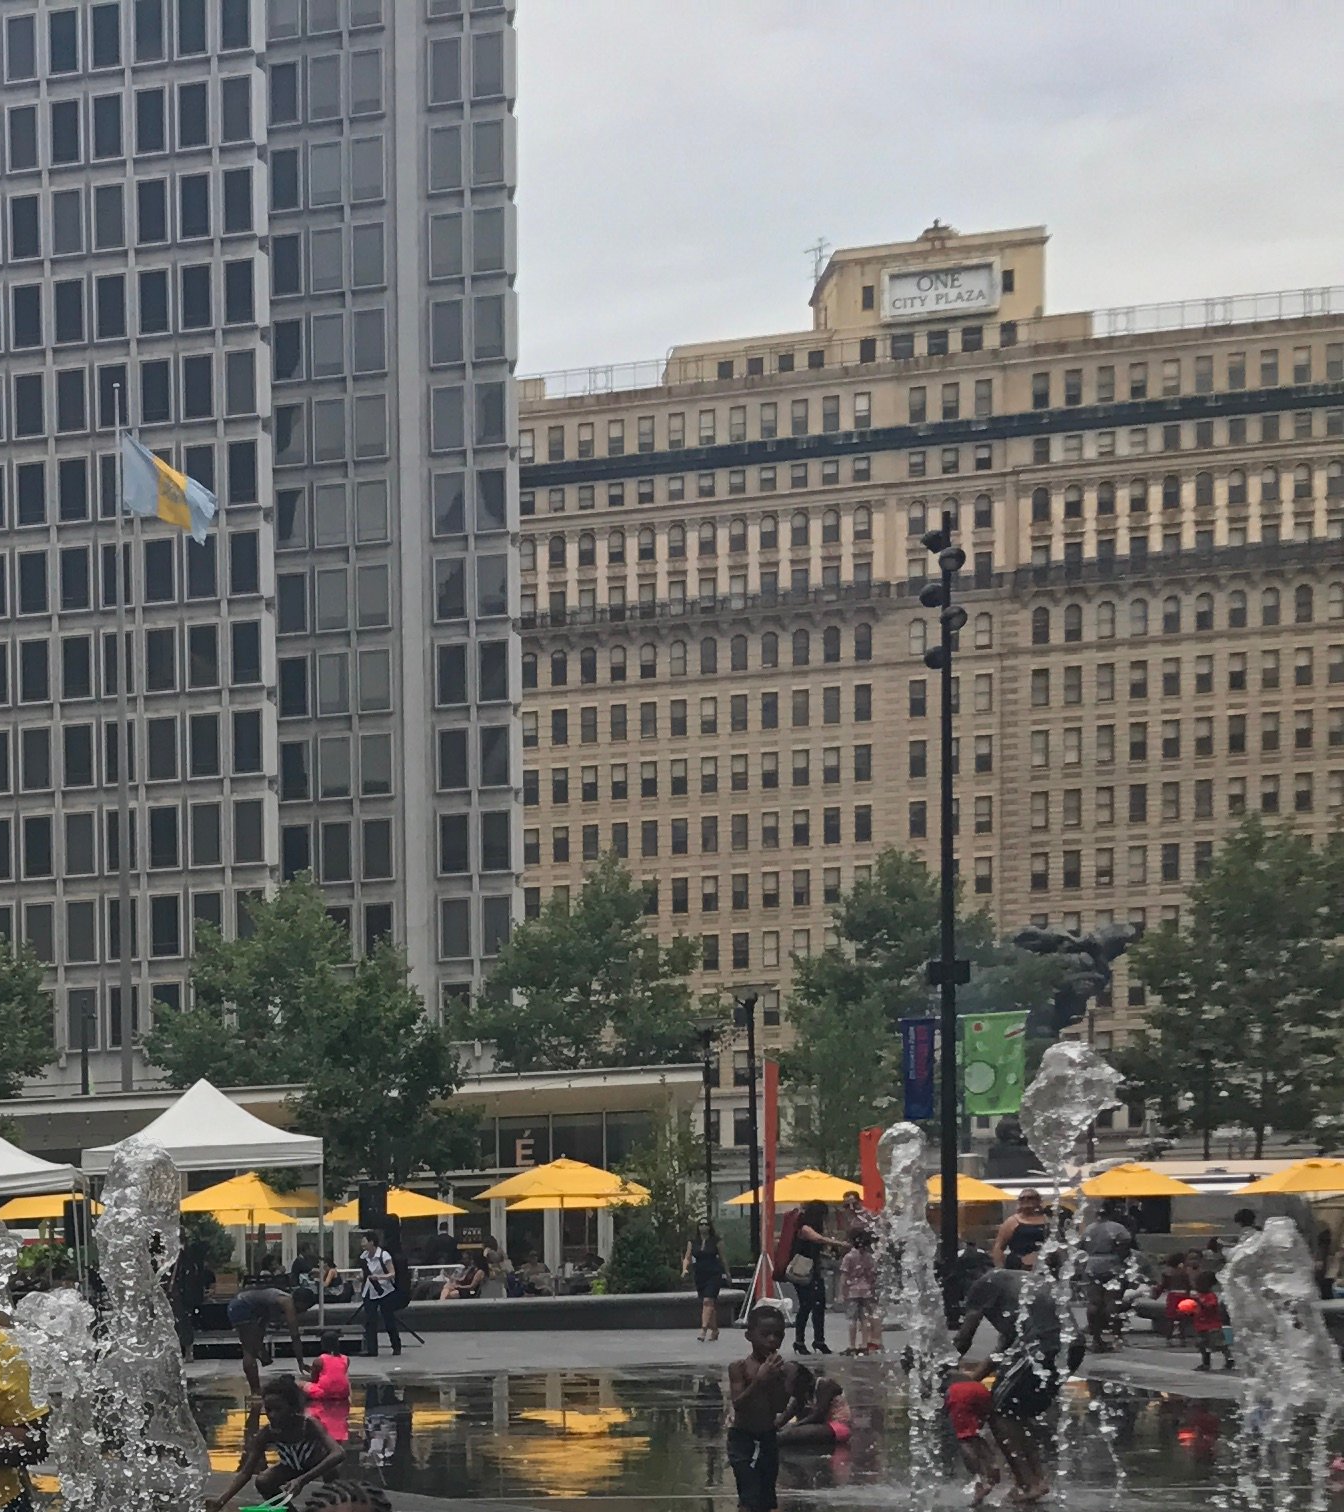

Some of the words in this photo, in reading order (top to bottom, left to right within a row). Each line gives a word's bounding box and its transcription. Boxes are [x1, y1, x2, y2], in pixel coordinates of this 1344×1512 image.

[916, 271, 963, 292] ONE
[892, 295, 928, 310] CITY
[935, 289, 987, 306] PLAZA
[514, 1128, 535, 1166] É
